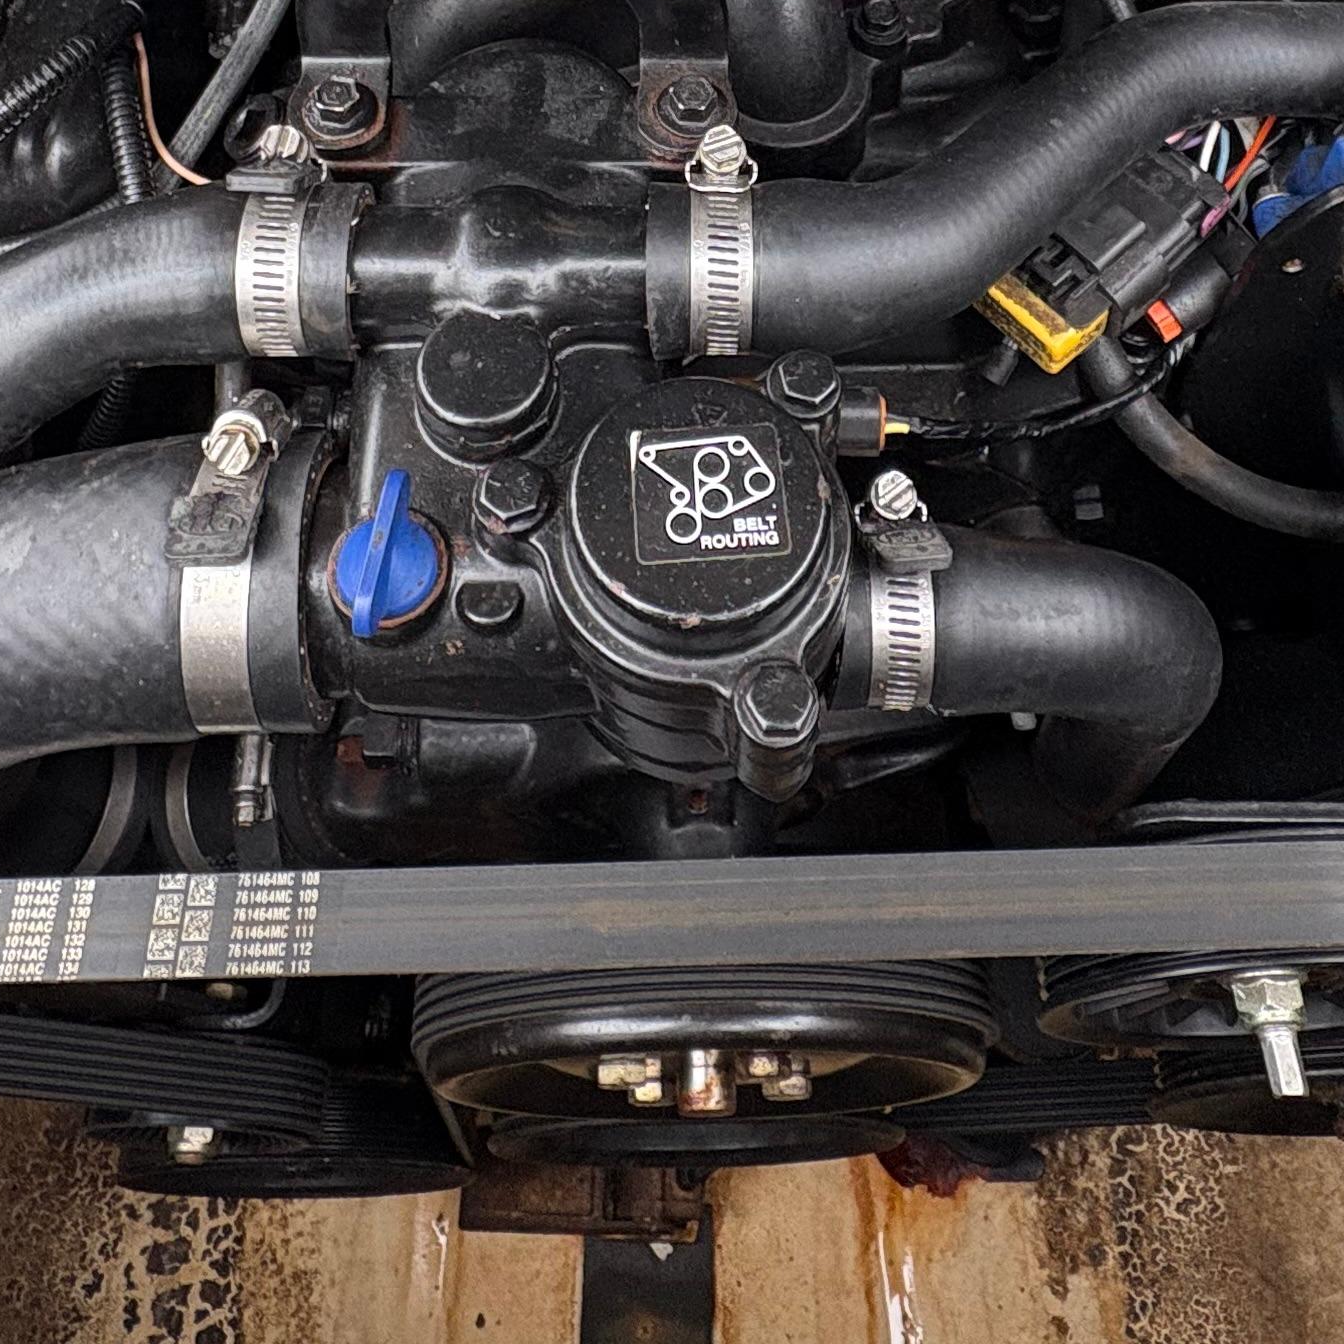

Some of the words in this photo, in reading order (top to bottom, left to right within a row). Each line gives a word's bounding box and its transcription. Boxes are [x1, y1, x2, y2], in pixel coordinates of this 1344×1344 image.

[733, 515, 778, 532] BELT
[700, 530, 779, 550] ROUTING
[17, 880, 62, 892] 1014AC
[238, 873, 295, 887] 761464MC
[301, 872, 320, 886] 108
[14, 894, 59, 906] 1014AC
[72, 893, 93, 905] 129
[236, 890, 292, 904] 761464MC
[299, 889, 318, 903] 109
[11, 908, 56, 920] 1014AC
[70, 907, 90, 919] 130
[233, 908, 291, 921] 761464MC
[297, 907, 316, 920] 110
[8, 922, 54, 934] 1014AC
[67, 921, 87, 933] 131
[231, 925, 288, 939] 761464MC
[295, 924, 314, 938] 111
[5, 935, 51, 947] 1014AC
[64, 934, 85, 946] 132
[2, 949, 48, 961] 1014AC
[62, 948, 82, 960] 133
[228, 943, 286, 957] 761464MC
[293, 942, 313, 956] 112
[0, 963, 45, 975] 1014AC
[58, 962, 79, 974] 134
[226, 962, 284, 975] 761464MC
[291, 961, 310, 974] 113
